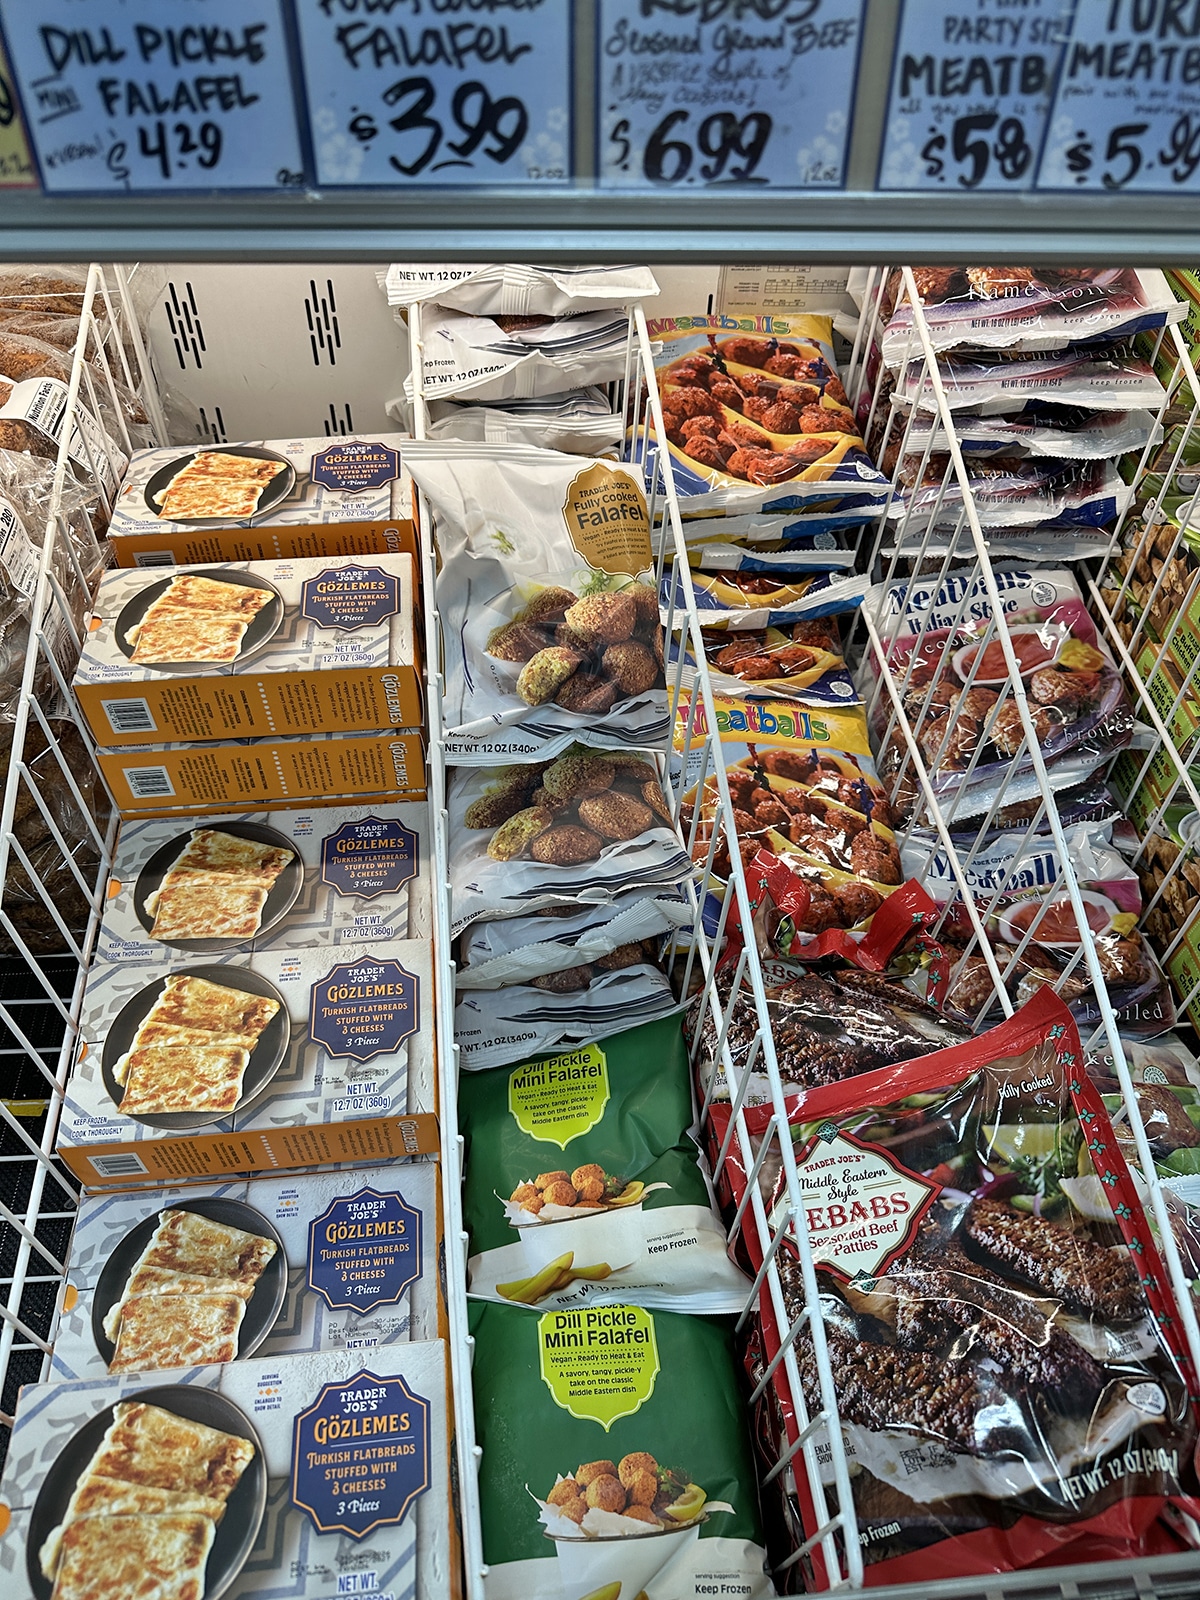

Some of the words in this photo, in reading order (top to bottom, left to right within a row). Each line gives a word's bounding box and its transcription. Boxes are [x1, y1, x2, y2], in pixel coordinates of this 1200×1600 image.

[791, 18, 856, 56] BEEF
[944, 16, 1024, 46] PARTY
[39, 24, 127, 73] DILL
[134, 23, 267, 67] PICKLE
[97, 74, 260, 117] FALAFEL
[399, 270, 417, 281] NET
[418, 271, 436, 281] WT.
[437, 271, 449, 281] 12
[646, 314, 791, 337] Meatballs
[434, 359, 456, 367] Frozen
[438, 374, 456, 383] WT.
[456, 372, 467, 381] 12
[578, 484, 610, 498] TRADER
[573, 499, 600, 512] Fully
[601, 492, 638, 504] Cooked
[576, 504, 644, 530] Falafel
[317, 581, 385, 593] GÖZLEMES
[380, 673, 403, 724] GÖZLEMES
[447, 731, 465, 740] Keep
[445, 743, 464, 752] NET
[464, 744, 480, 753] WT.
[482, 743, 493, 753] 12
[494, 743, 507, 753] OZ
[388, 741, 409, 787] GÖZLEMES
[336, 838, 404, 853] GÖZLEMES
[332, 856, 362, 865] TURKISH
[361, 879, 383, 887] Pieces
[355, 917, 368, 925] NET
[370, 916, 382, 924] WT.
[343, 929, 357, 937] 12.7
[360, 928, 369, 936] OZ
[371, 926, 394, 937] (360g)
[348, 967, 385, 976] TRADER
[328, 983, 404, 1002] GÖZLEMES
[322, 1007, 356, 1018] TURKISH
[359, 1003, 408, 1013] FLATBREADS
[1085, 1001, 1164, 1021] boiled
[336, 1016, 370, 1025] STUFFED
[373, 1014, 393, 1022] WITH
[350, 1024, 384, 1034] CHEESES
[460, 1028, 482, 1038] Frozen
[354, 1036, 379, 1046] Pieces
[463, 1041, 482, 1053] WT.
[481, 1039, 494, 1049] 12
[548, 1053, 591, 1070] Pickle
[513, 1073, 546, 1090] Mini
[548, 1063, 602, 1084] Falafel
[347, 1085, 362, 1095] NET
[365, 1083, 378, 1094] WT.
[997, 1084, 1020, 1100] Fully
[1021, 1074, 1054, 1094] Cooked
[517, 1093, 536, 1101] Vegan
[540, 1088, 558, 1098] Ready
[333, 1100, 351, 1111] 12.7
[354, 1100, 363, 1109] OZ
[366, 1097, 391, 1110] (360g)
[567, 1103, 587, 1112] classic
[87, 1116, 108, 1124] FROZEN
[531, 1118, 552, 1126] Middle
[552, 1114, 576, 1123] Eastern
[576, 1111, 589, 1119] dish
[88, 1127, 123, 1137] THOROUGHLY
[400, 1119, 420, 1153] GÖZLEMES
[804, 1157, 837, 1174] TRADER
[837, 1154, 862, 1164] JOE'S
[798, 1174, 839, 1190] Middle
[842, 1168, 888, 1185] Eastern
[827, 1185, 859, 1204] Style
[347, 1201, 386, 1212] TRADER
[788, 1191, 911, 1235] EBABS
[350, 1210, 379, 1220] JOE'S
[326, 1220, 405, 1244] GÖZLEMES
[809, 1229, 867, 1249] Seasoned
[868, 1219, 900, 1237] Beef
[320, 1249, 356, 1261] TURKISH
[359, 1244, 409, 1256] FLATBREADS
[647, 1243, 669, 1255] Keep
[669, 1236, 698, 1250] Frozen
[834, 1239, 879, 1257] Patties
[335, 1260, 370, 1270] STUFFED
[350, 1270, 385, 1280] CHEESES
[355, 1284, 380, 1295] Pieces
[556, 1293, 578, 1304] NET
[555, 1313, 582, 1330] Dill
[586, 1311, 637, 1328] Pickle
[347, 1340, 362, 1348] NET
[545, 1330, 584, 1349] Mini
[587, 1327, 650, 1346] Falafel
[550, 1356, 573, 1364] Vegan
[577, 1354, 599, 1363] Ready
[609, 1352, 626, 1360] Heat
[633, 1351, 645, 1359] Eat
[614, 1366, 642, 1376] pickle-y
[569, 1379, 586, 1387] take
[597, 1377, 610, 1385] the
[611, 1376, 634, 1384] classic
[340, 1388, 386, 1402] TRADER
[568, 1389, 593, 1397] Middle
[593, 1387, 621, 1396] Eastern
[621, 1385, 637, 1393] dish
[344, 1400, 378, 1413] JOE'S
[314, 1413, 410, 1445] GÖZLEMES
[307, 1452, 350, 1469] TURKISH
[354, 1444, 415, 1460] FLATBREADS
[325, 1466, 368, 1480] STUFFED
[371, 1462, 397, 1474] WITH
[1059, 1475, 1086, 1503] NET
[1082, 1468, 1110, 1494] WT.
[1107, 1458, 1126, 1480] 12
[1123, 1449, 1145, 1474] OZ
[332, 1481, 340, 1495] 3
[342, 1478, 386, 1493] CHEESES
[348, 1498, 380, 1514] Pieces
[867, 1520, 901, 1542] Frozen
[338, 1574, 358, 1593] NET
[360, 1572, 379, 1590] WT.
[694, 1583, 719, 1596] Keep
[720, 1583, 752, 1595] Frozen
